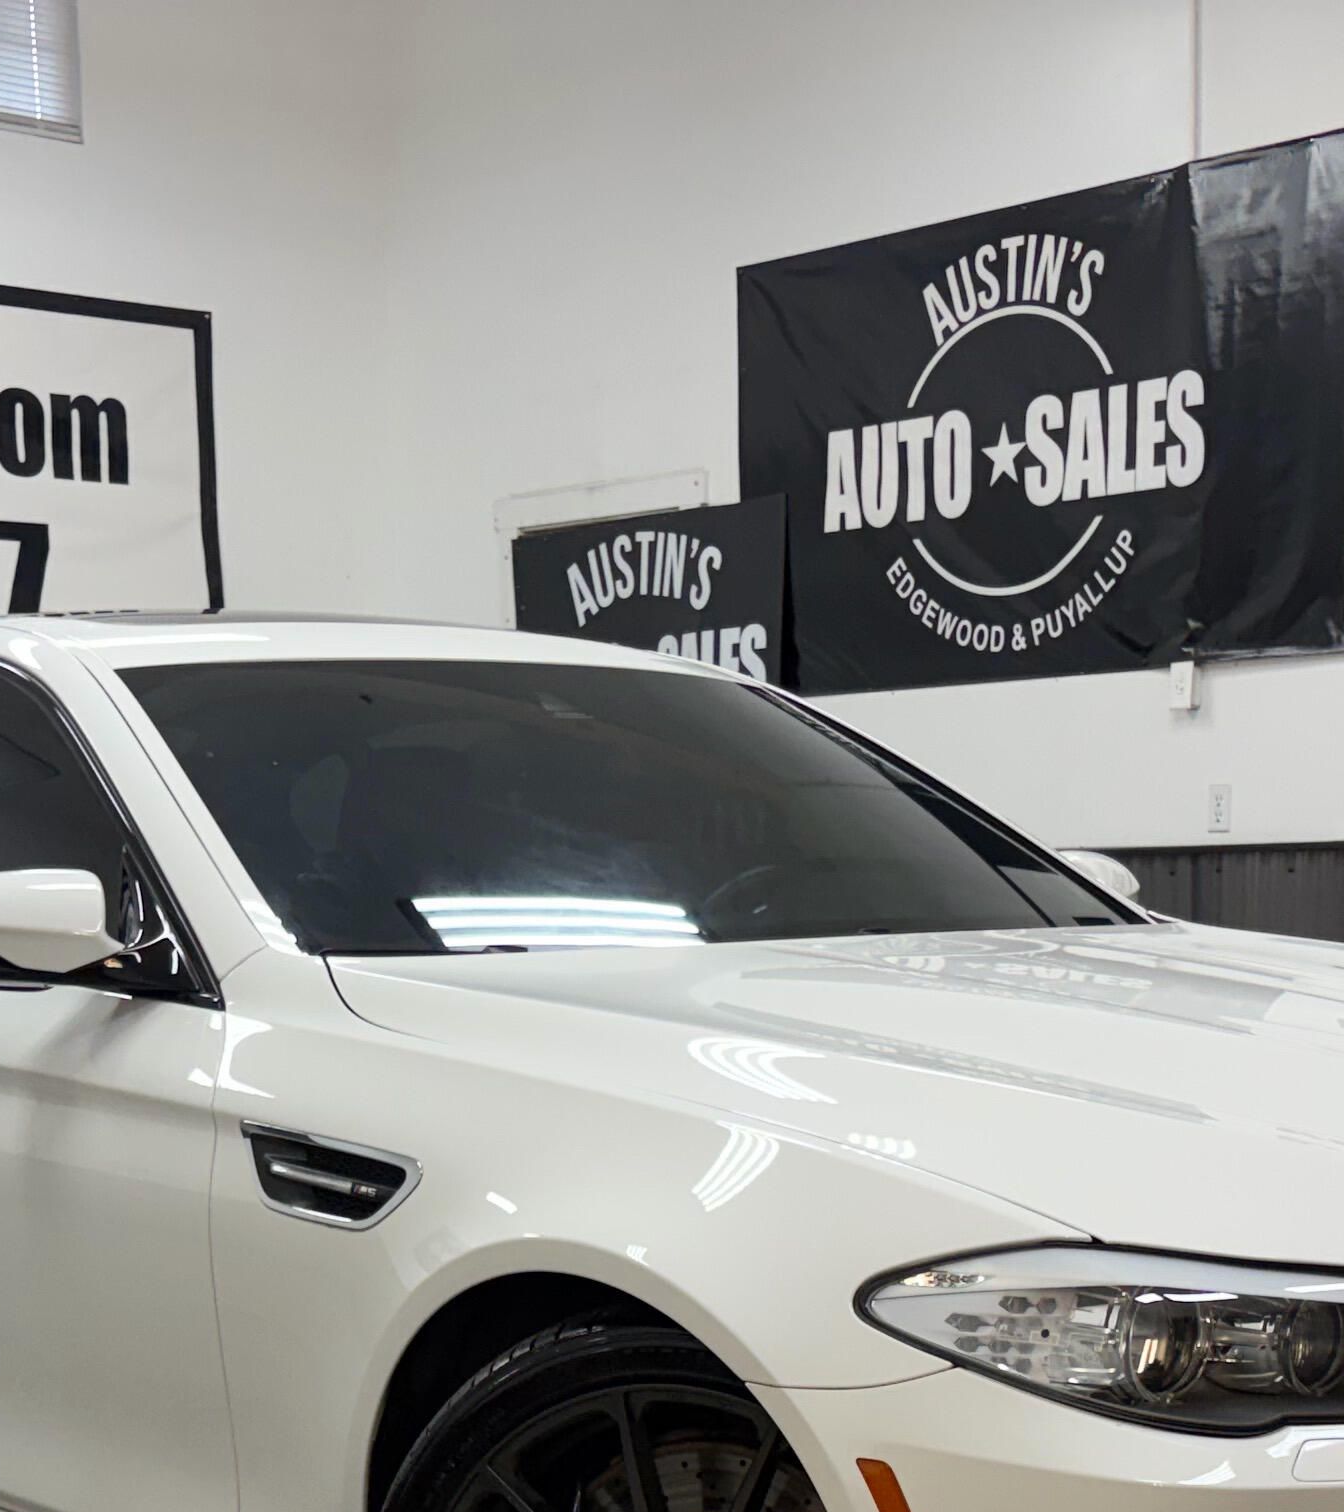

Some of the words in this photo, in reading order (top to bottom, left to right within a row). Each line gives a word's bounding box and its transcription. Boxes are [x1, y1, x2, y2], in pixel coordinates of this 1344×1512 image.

[922, 234, 1105, 347] AUSTIN'S
[823, 409, 973, 534] AUTO
[1024, 369, 1205, 507] SALES
[566, 530, 723, 628] AUSTIN'S
[885, 556, 1005, 653] EDGEWOOD
[1011, 622, 1027, 651] &
[1030, 529, 1135, 647] PUYALLUP
